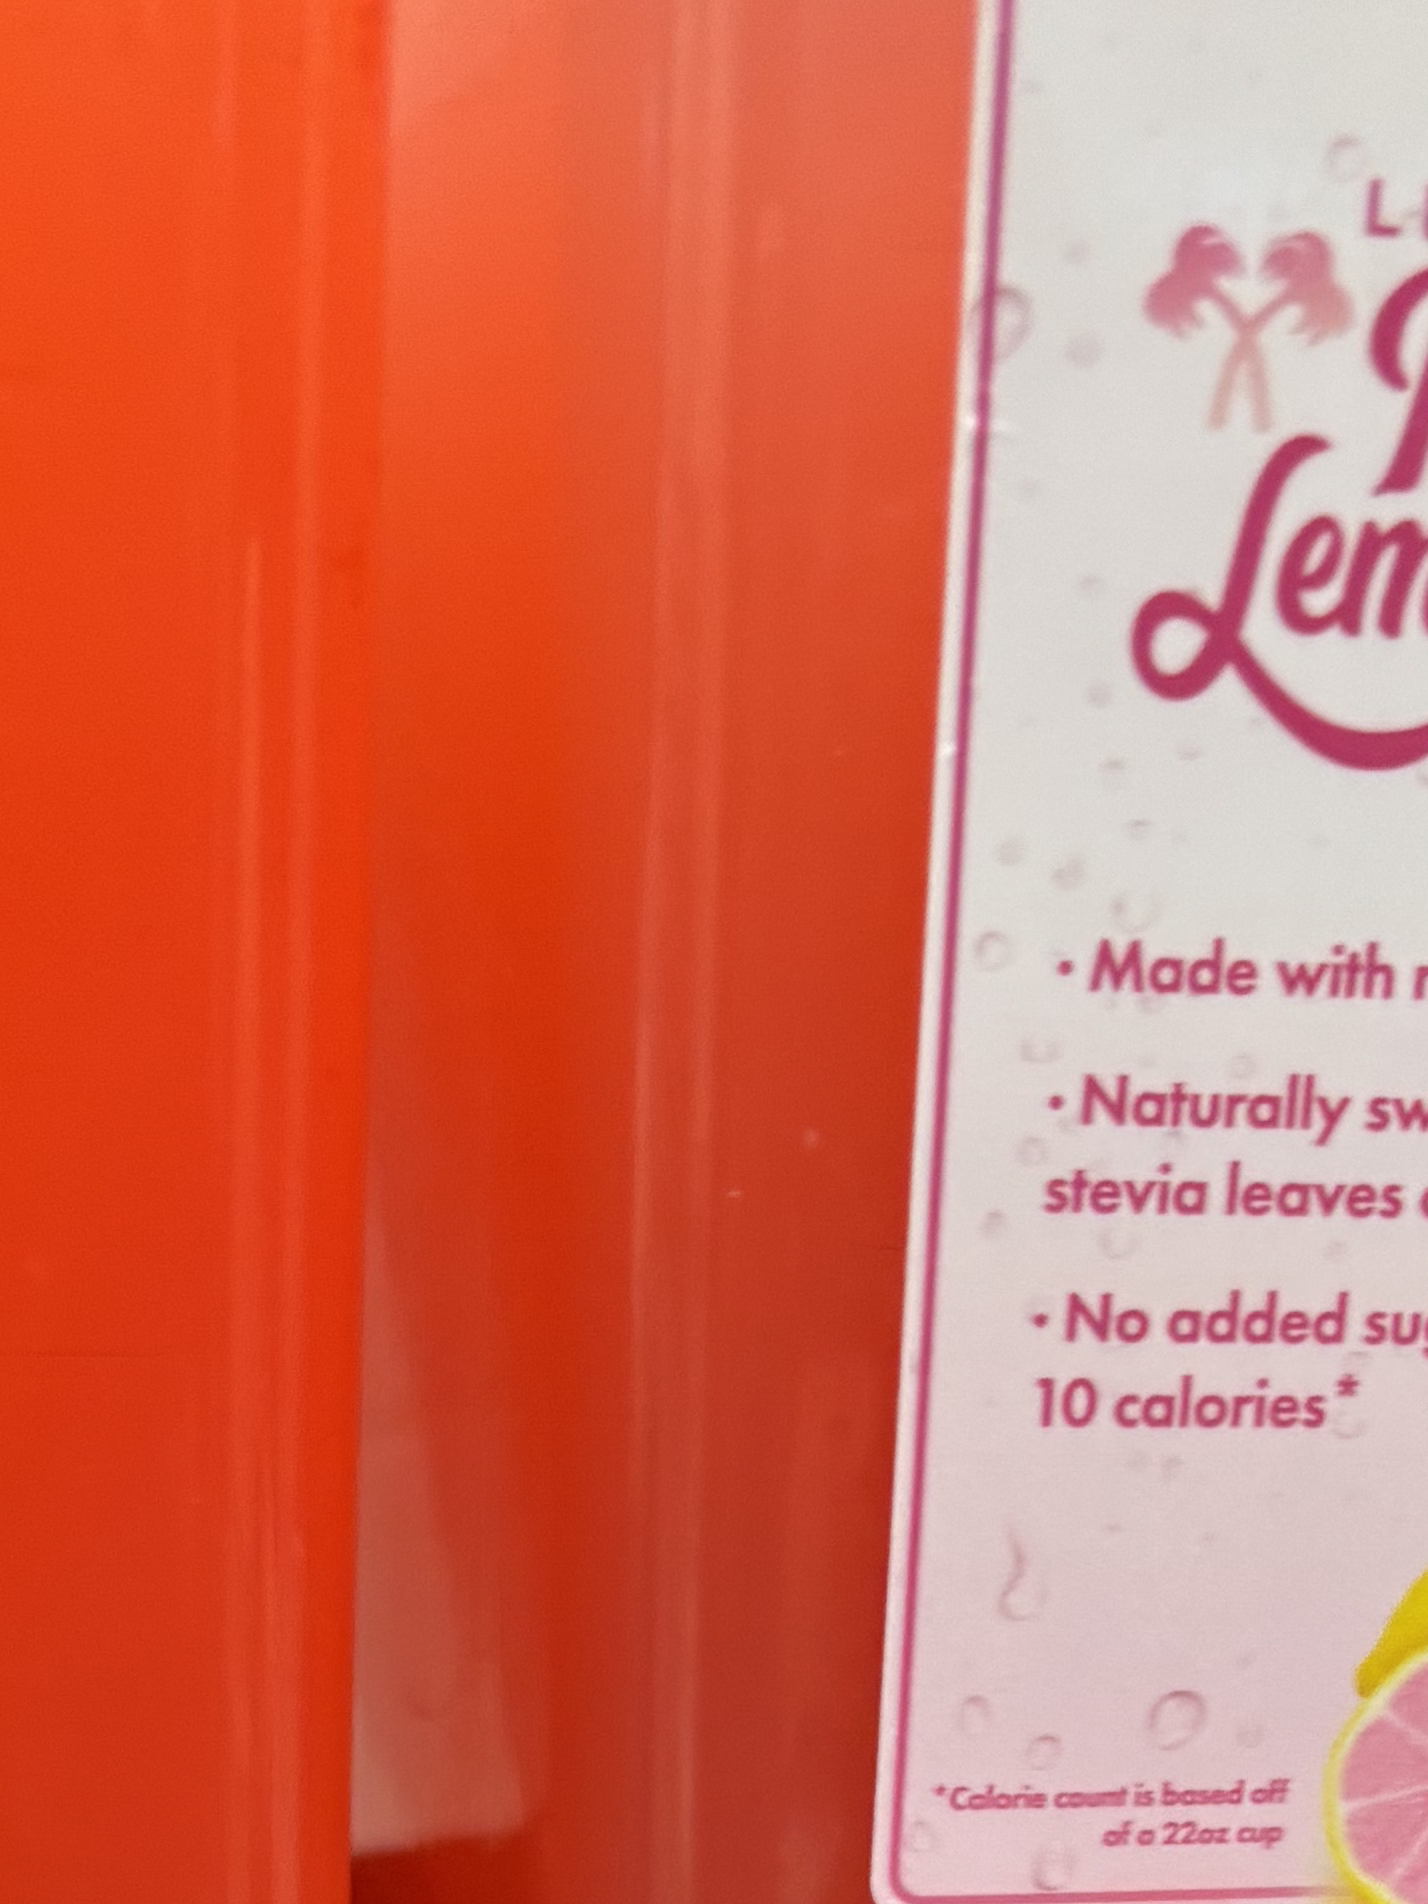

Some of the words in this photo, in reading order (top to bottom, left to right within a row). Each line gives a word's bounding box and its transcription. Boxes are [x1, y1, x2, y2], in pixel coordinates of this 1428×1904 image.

[1088, 938, 1258, 998] Made
[1277, 943, 1395, 999] with
[1079, 1075, 1351, 1147] Naturally
[1043, 1163, 1207, 1217] stevia
[1225, 1161, 1403, 1221] leaves
[1063, 1291, 1152, 1346] No
[1165, 1289, 1349, 1346] added
[1035, 1377, 1099, 1429] 10
[1052, 1786, 1127, 1808] count
[1133, 1783, 1154, 1807] is
[1160, 1779, 1243, 1806] based
[1249, 1777, 1291, 1804] off
[1101, 1820, 1132, 1847] of
[1136, 1828, 1155, 1847] a
[1162, 1820, 1230, 1846] 22oz
[1236, 1825, 1285, 1851] cup
